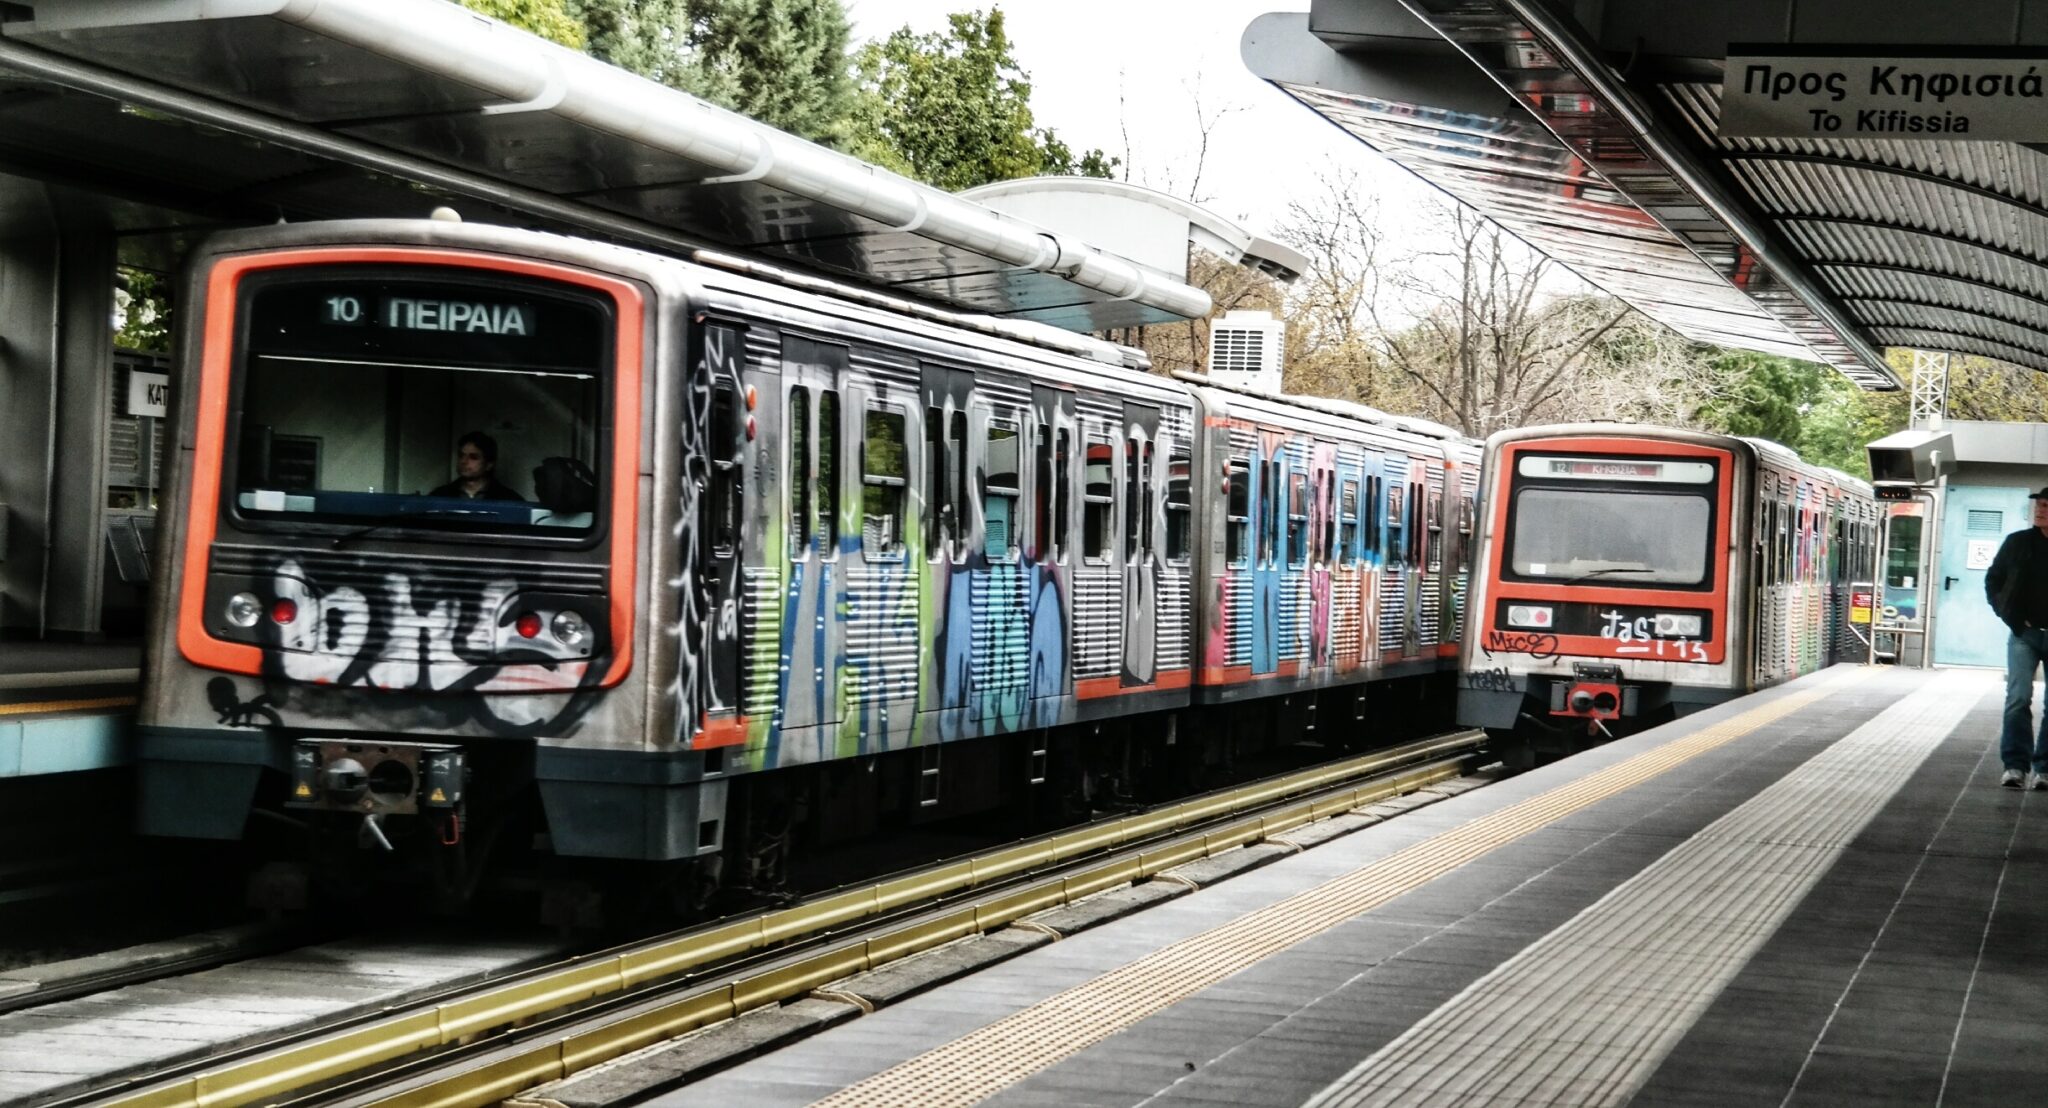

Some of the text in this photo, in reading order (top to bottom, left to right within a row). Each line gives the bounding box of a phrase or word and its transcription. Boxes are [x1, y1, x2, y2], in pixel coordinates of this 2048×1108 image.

[1744, 65, 2043, 103] Προς Κηφισιά
[1809, 109, 1970, 134] To Kifissia
[327, 297, 527, 336] 10 ΠΕΙΡΑΙΑ
